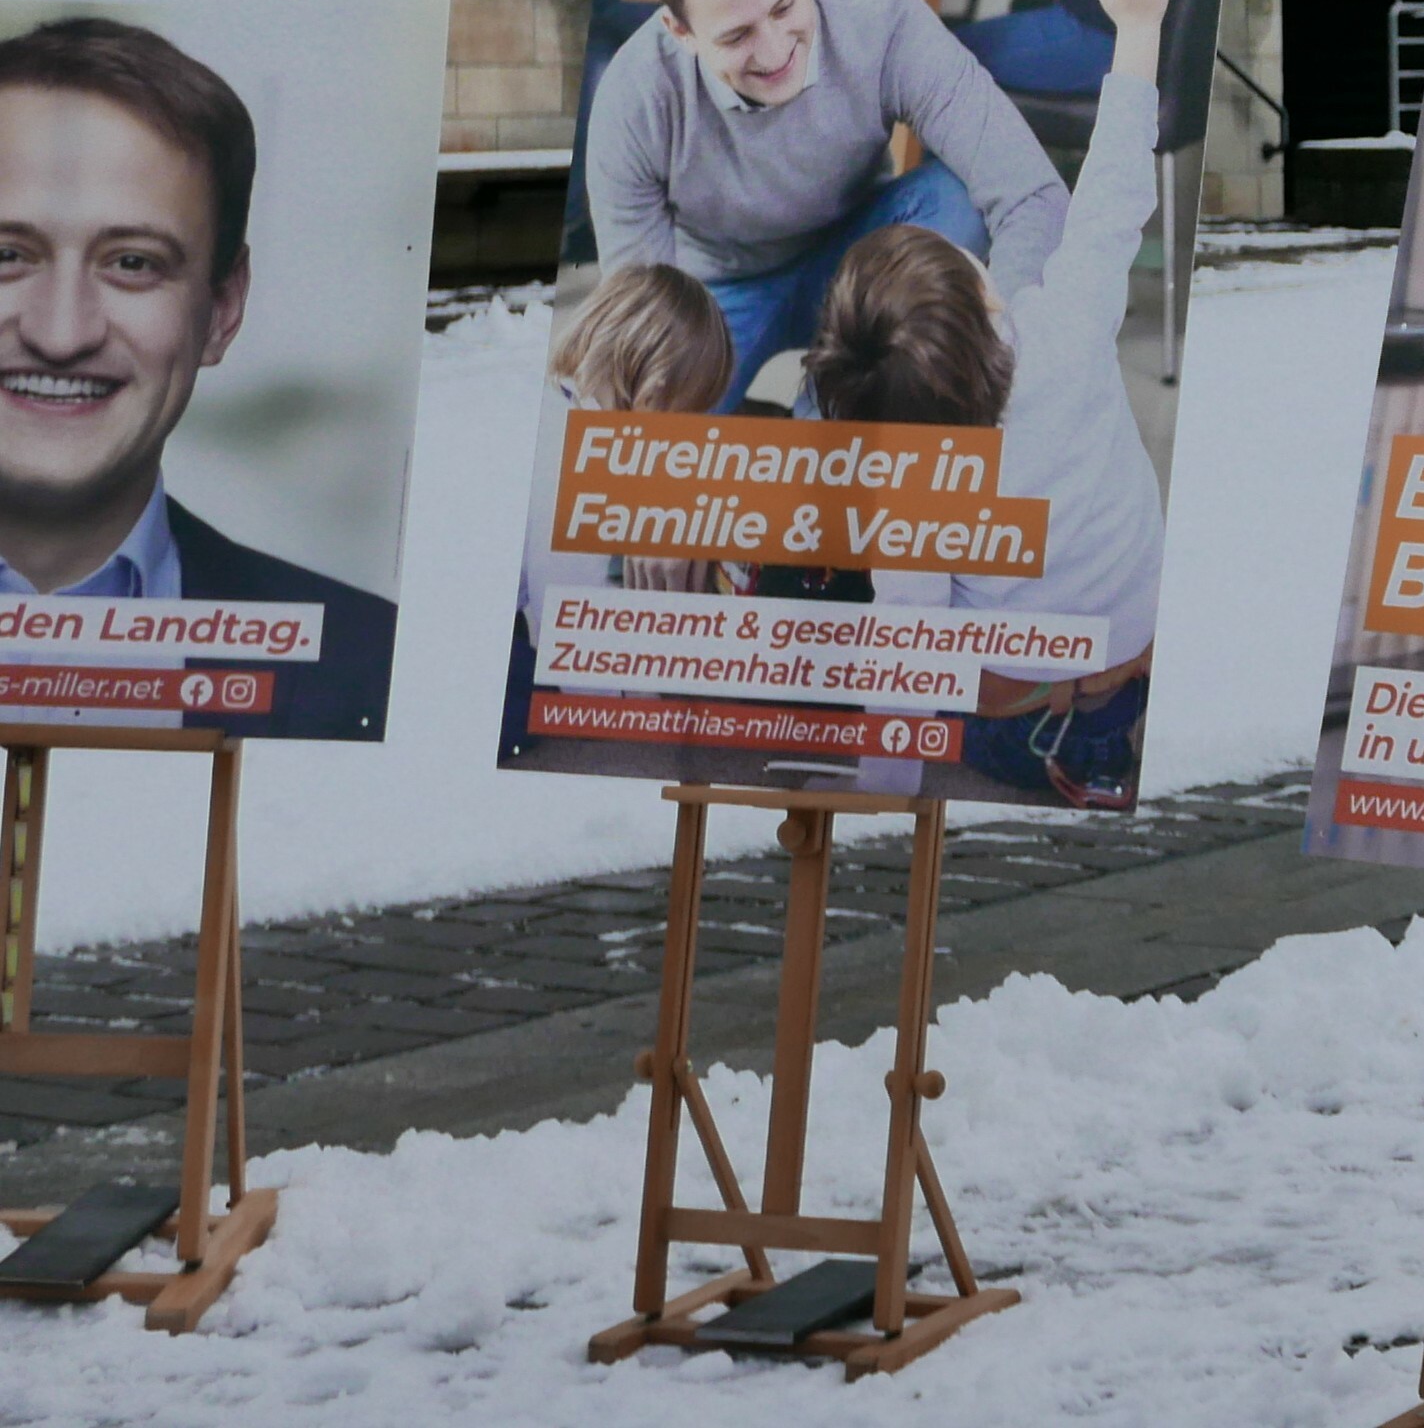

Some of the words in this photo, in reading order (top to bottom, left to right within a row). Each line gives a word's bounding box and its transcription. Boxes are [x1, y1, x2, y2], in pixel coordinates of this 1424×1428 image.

[575, 426, 918, 488] Füreinander
[931, 438, 985, 492] in
[566, 493, 767, 549] Familie
[783, 504, 822, 552] &
[846, 507, 1035, 564] Verein.
[99, 607, 310, 655] Landtag.
[555, 599, 728, 638] Ehrenamt
[736, 611, 760, 640] &
[769, 613, 1094, 660] gesellschaftlichen
[548, 642, 812, 688] Zusammenhalt
[824, 658, 966, 698] stärken.
[542, 704, 867, 748] www.matthias-miller.net
[1358, 724, 1394, 760] in
